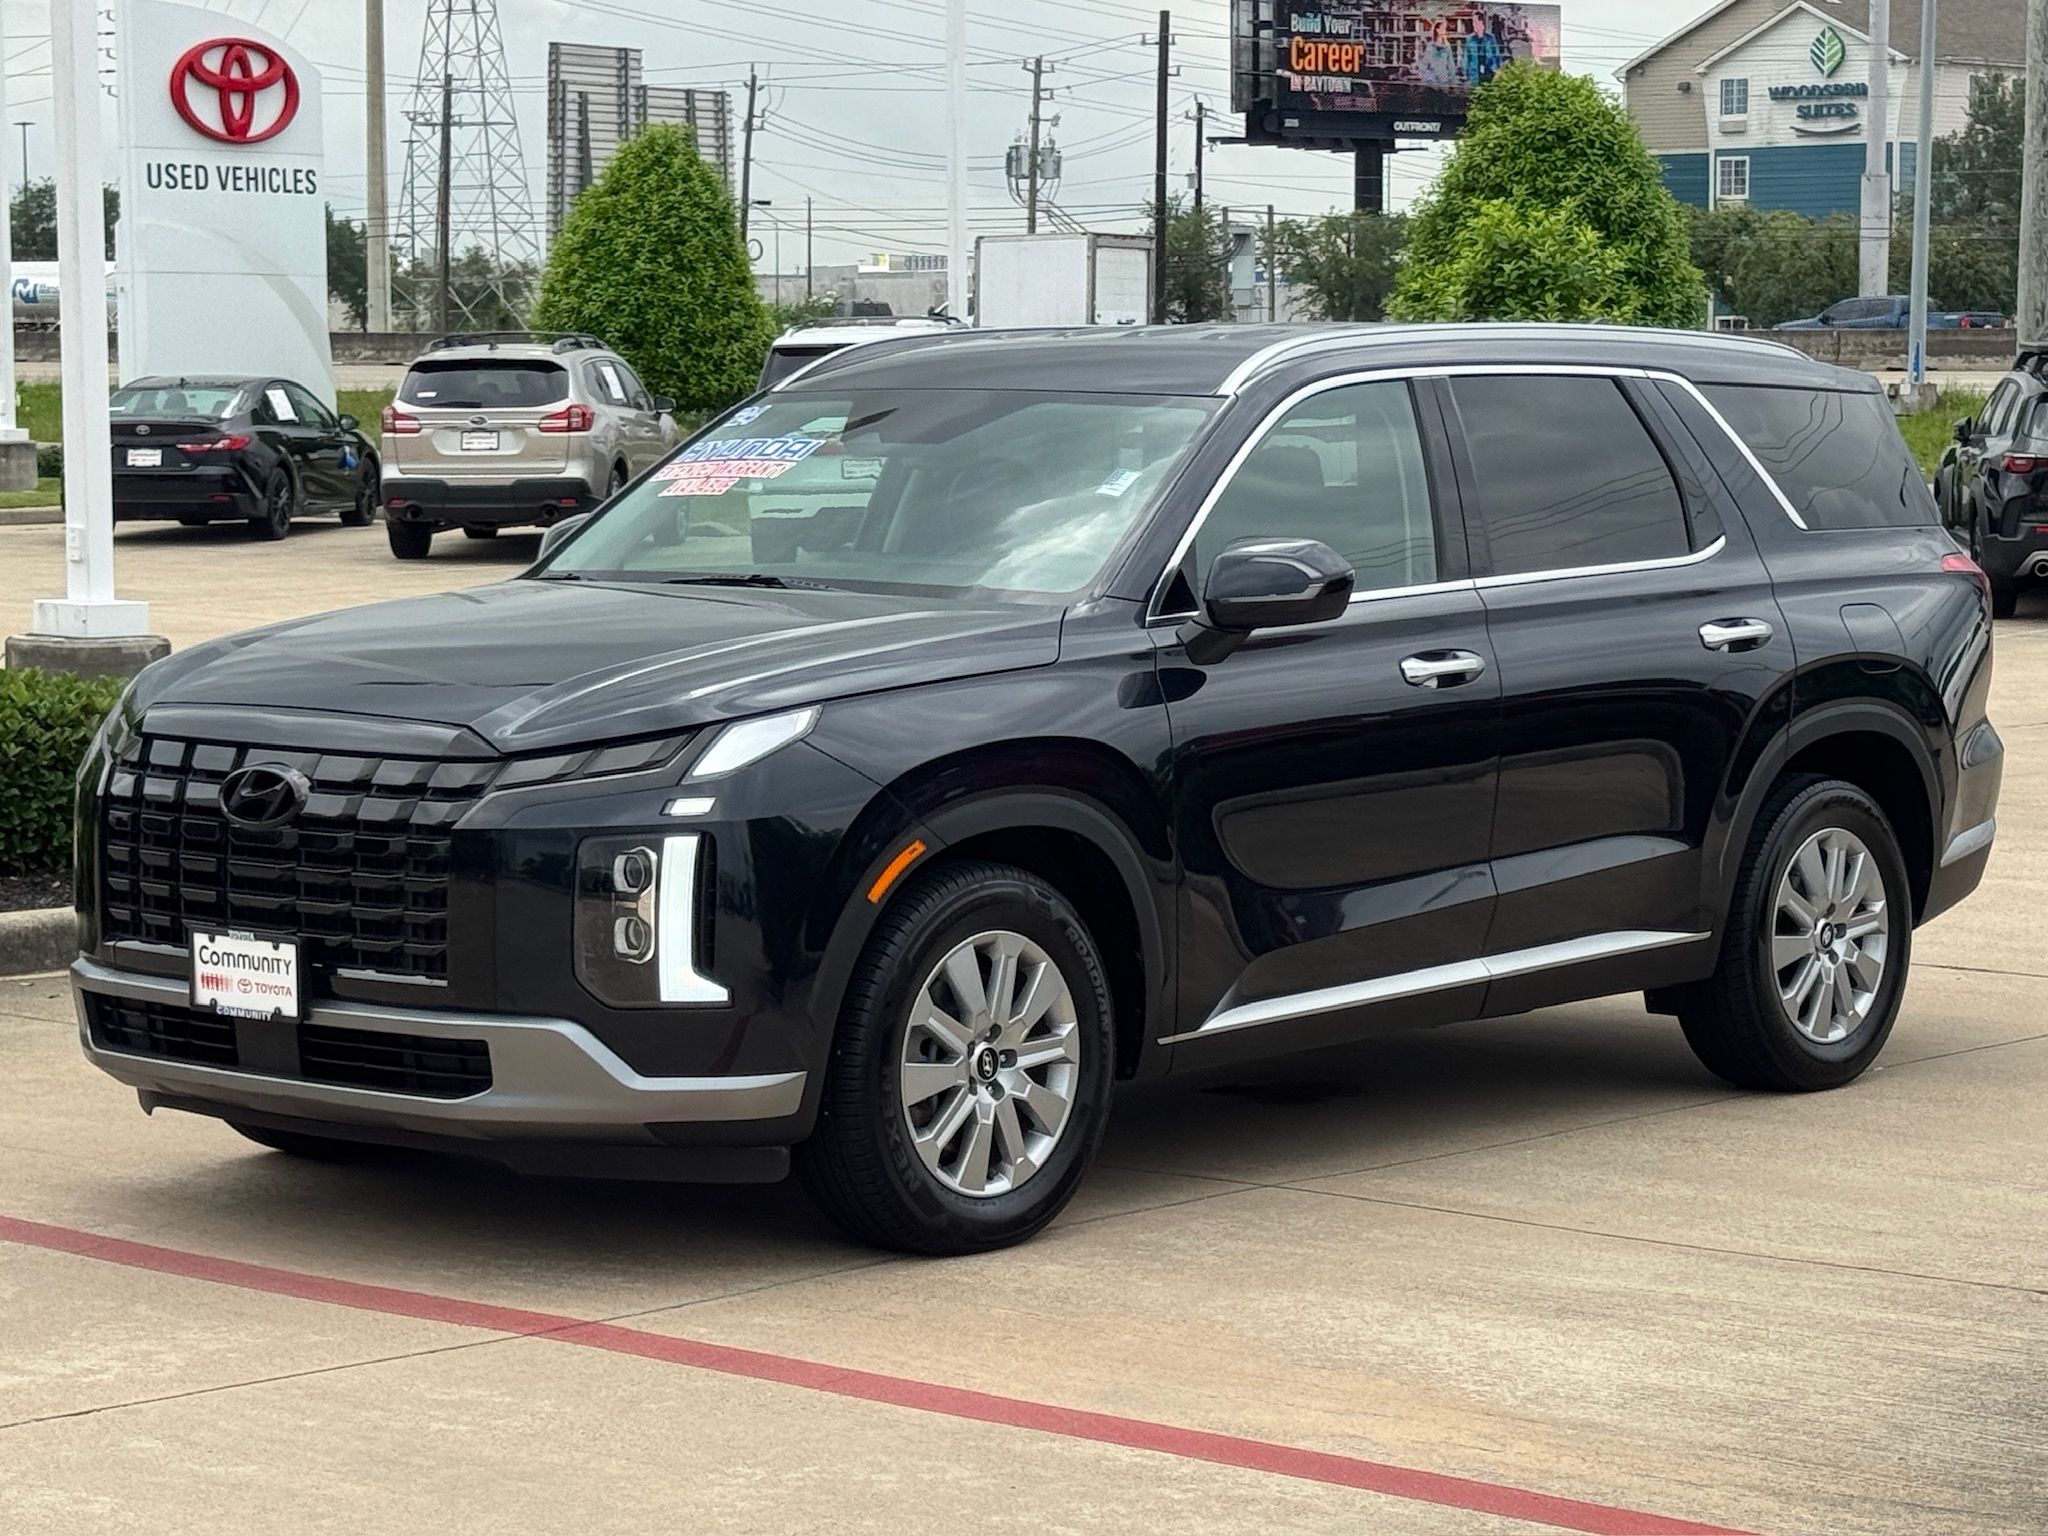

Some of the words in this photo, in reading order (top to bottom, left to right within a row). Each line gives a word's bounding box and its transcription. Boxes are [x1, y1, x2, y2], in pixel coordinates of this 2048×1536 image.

[1291, 13, 1321, 33] Build
[1323, 15, 1352, 34] Your
[1291, 36, 1364, 73] Career
[1303, 76, 1351, 93] BAYTOWN
[1768, 83, 1868, 100] WOODSPRIN
[1796, 103, 1857, 119] SUITES
[147, 163, 208, 190] USED
[216, 165, 317, 195] VEHICLES
[675, 438, 826, 462] HYUNDAI
[254, 982, 292, 997] TOYOTA
[216, 1006, 272, 1021] COMMUNITY
